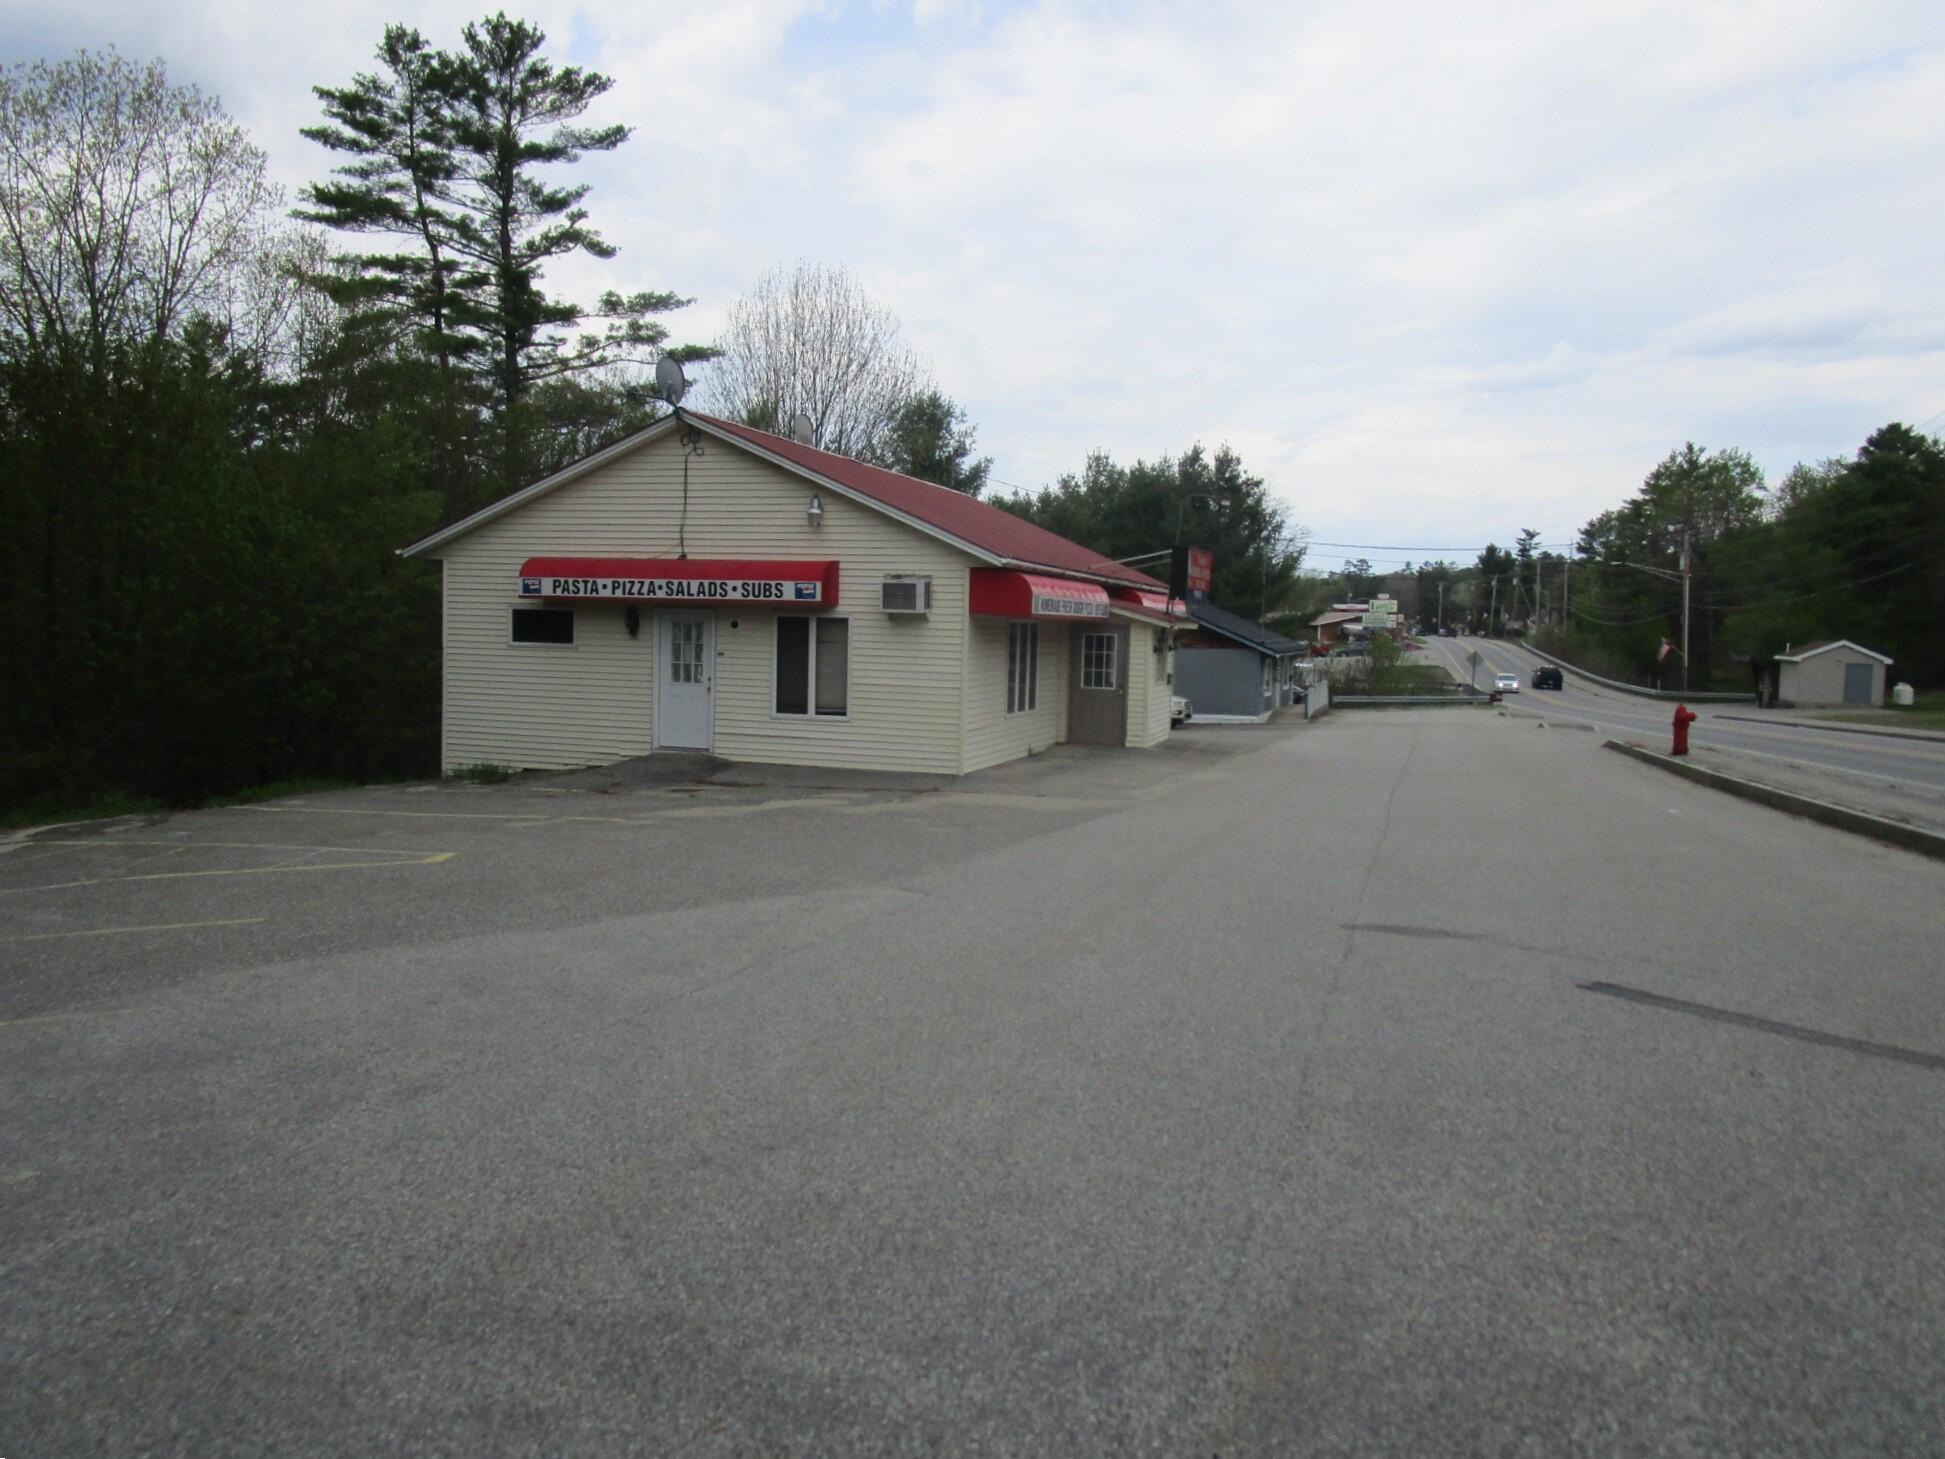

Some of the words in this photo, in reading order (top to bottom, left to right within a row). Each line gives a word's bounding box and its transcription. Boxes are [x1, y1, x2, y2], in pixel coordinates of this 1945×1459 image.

[552, 579, 599, 595] PASTA
[611, 581, 657, 596] PIZZA
[664, 581, 728, 597] SALADS
[741, 583, 784, 598] SUBS
